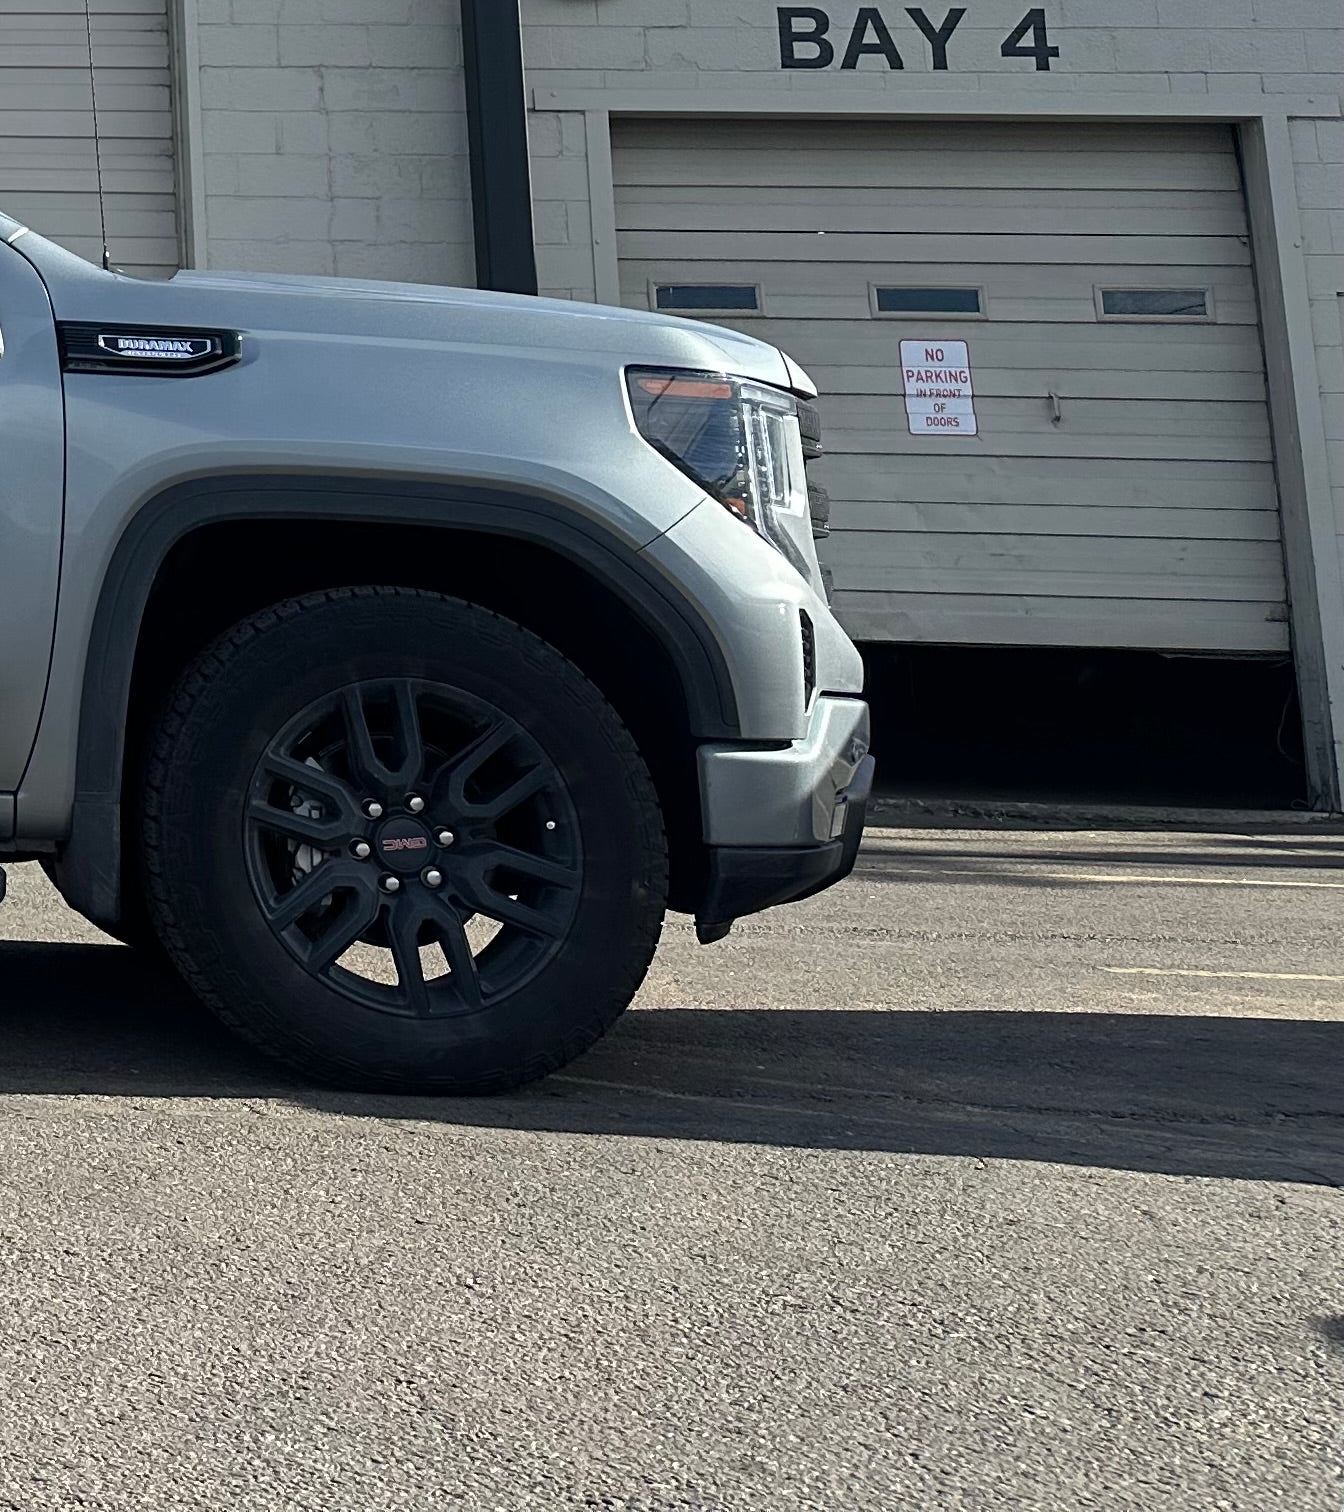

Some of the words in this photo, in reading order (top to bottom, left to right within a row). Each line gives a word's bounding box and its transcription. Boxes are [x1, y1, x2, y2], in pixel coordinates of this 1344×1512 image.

[776, 6, 968, 70] BAY
[1000, 7, 1060, 71] 4
[117, 338, 194, 352] DURAMAX
[924, 348, 945, 362] NO
[905, 369, 968, 384] PARKING
[916, 388, 928, 398] IN
[928, 388, 962, 399] FRONT
[933, 403, 947, 413] OF
[925, 416, 960, 427] DOORS
[382, 837, 427, 851] GMC
